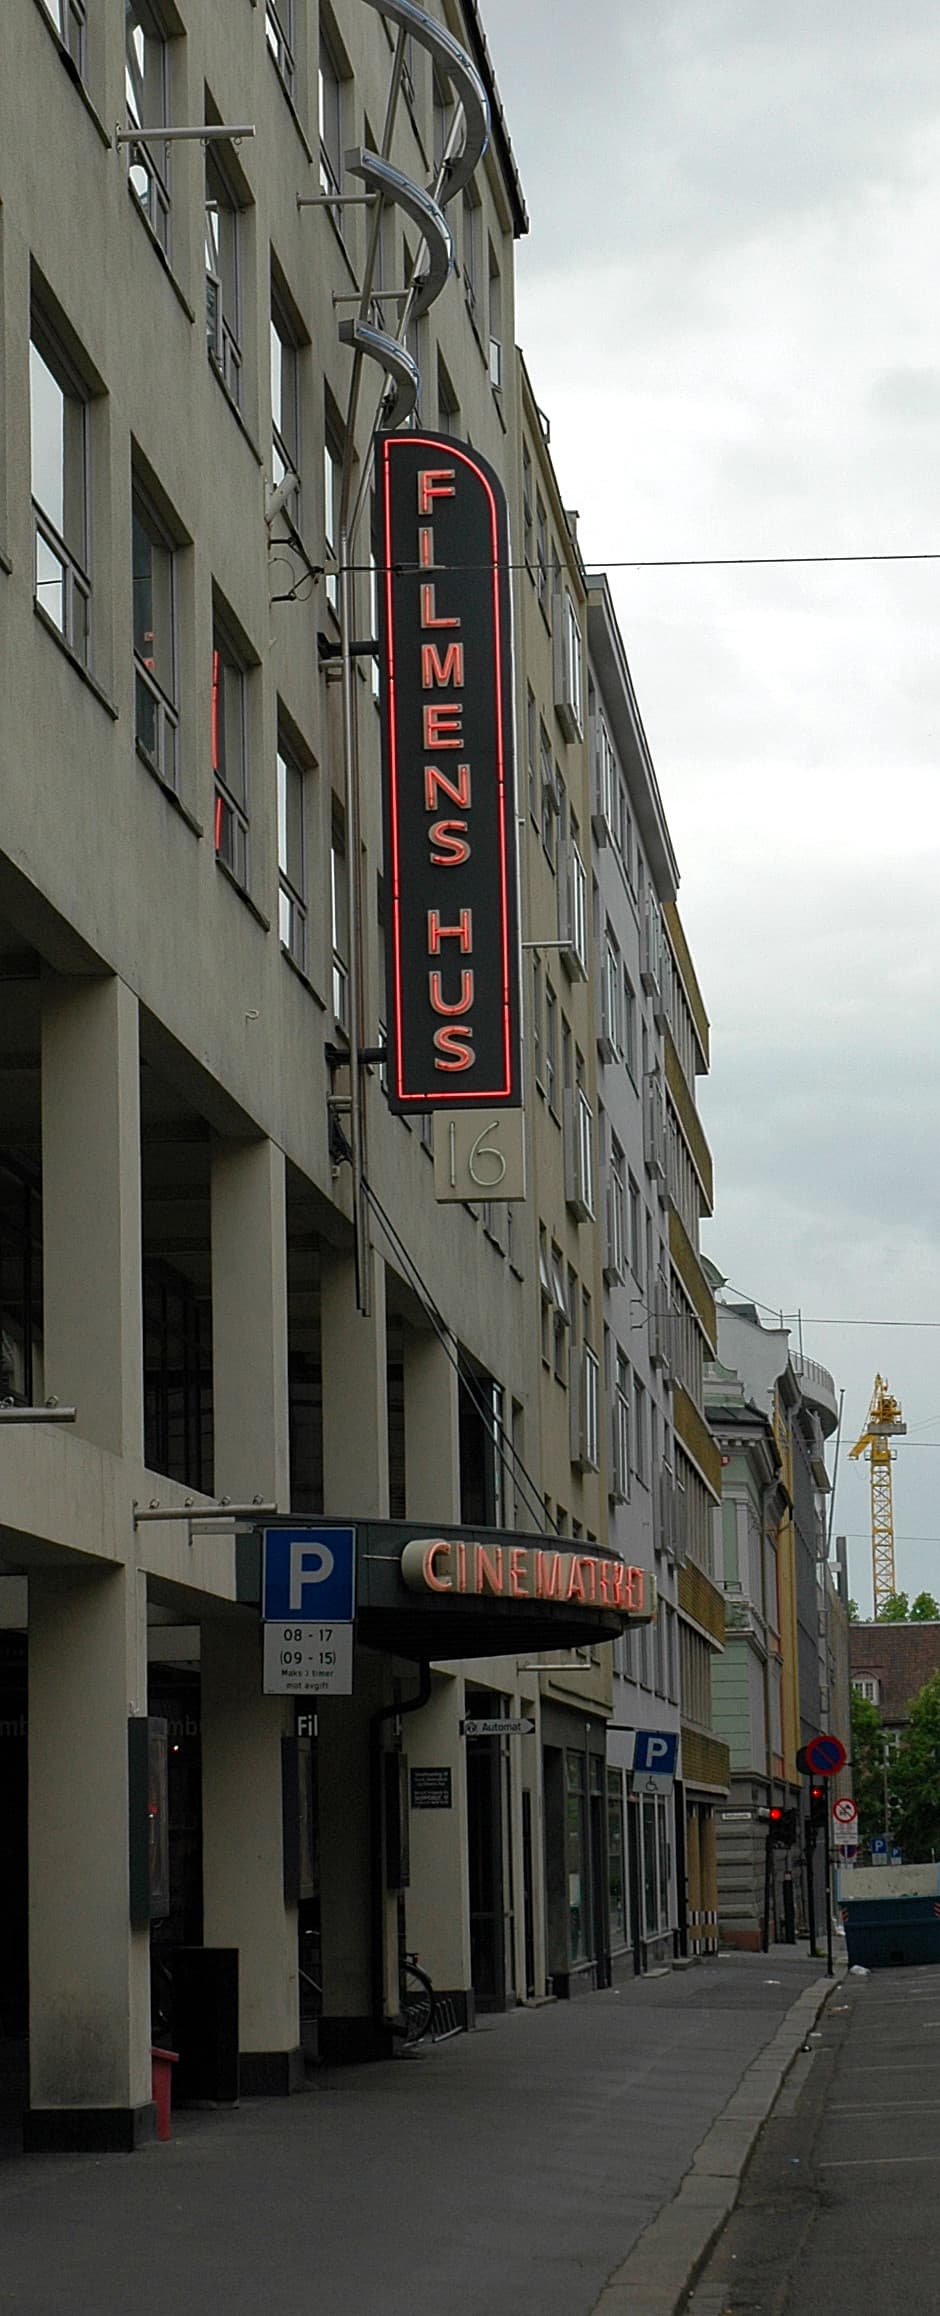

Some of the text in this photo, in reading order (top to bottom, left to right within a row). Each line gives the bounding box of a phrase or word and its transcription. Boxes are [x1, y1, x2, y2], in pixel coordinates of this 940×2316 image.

[418, 468, 475, 1073] FILMENS HUS
[449, 1120, 506, 1187] 16
[289, 1542, 334, 1610] P
[283, 1628, 302, 1642] 08
[319, 1629, 333, 1642] 17
[280, 1650, 302, 1665] (09
[319, 1650, 336, 1665] 15)
[281, 1669, 302, 1677] Maks
[311, 1669, 334, 1677] timer
[304, 1681, 329, 1690] avgift
[482, 1722, 521, 1731] Automat
[646, 1737, 668, 1767] P
[874, 1839, 884, 1852] P
